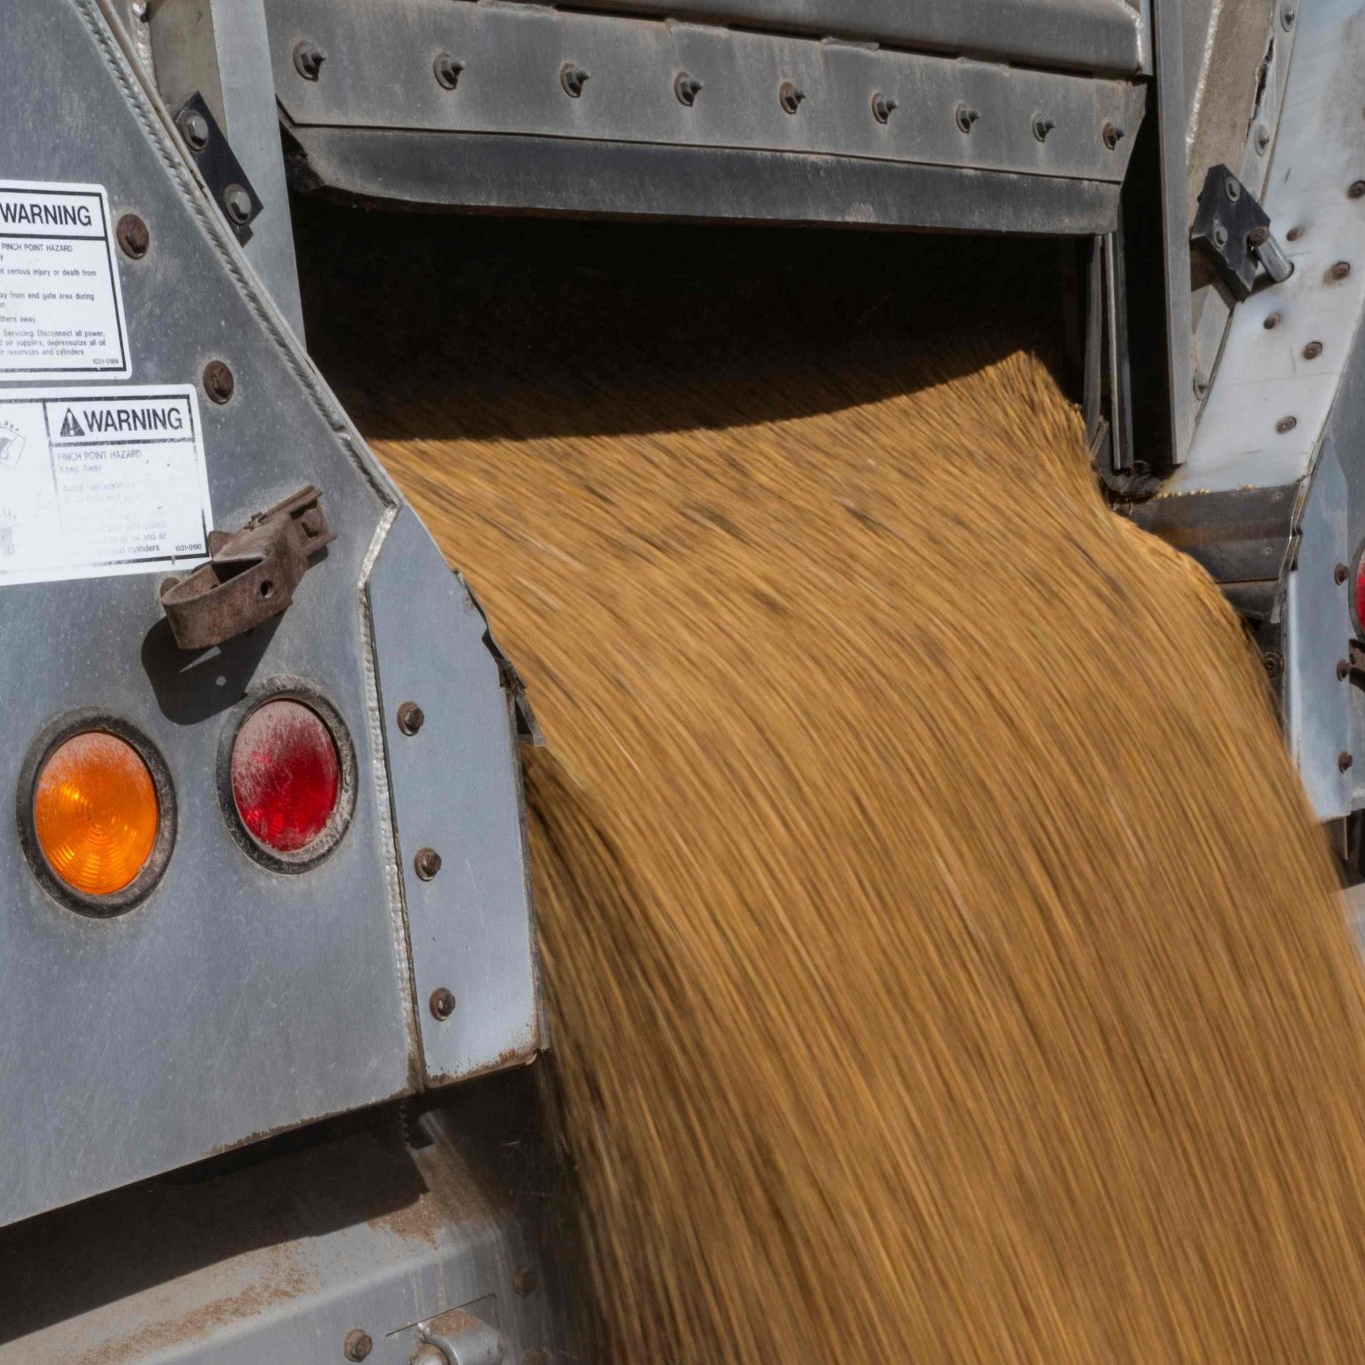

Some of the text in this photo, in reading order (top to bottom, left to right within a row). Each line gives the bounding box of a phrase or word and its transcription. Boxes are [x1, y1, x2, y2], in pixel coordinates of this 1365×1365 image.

[0, 202, 91, 226] WARNING
[47, 244, 73, 252] HAZARD
[33, 269, 50, 277] injury
[75, 293, 94, 301] during
[84, 407, 183, 432] WARNING
[85, 451, 106, 460] POINT
[110, 450, 141, 459] HAZARD
